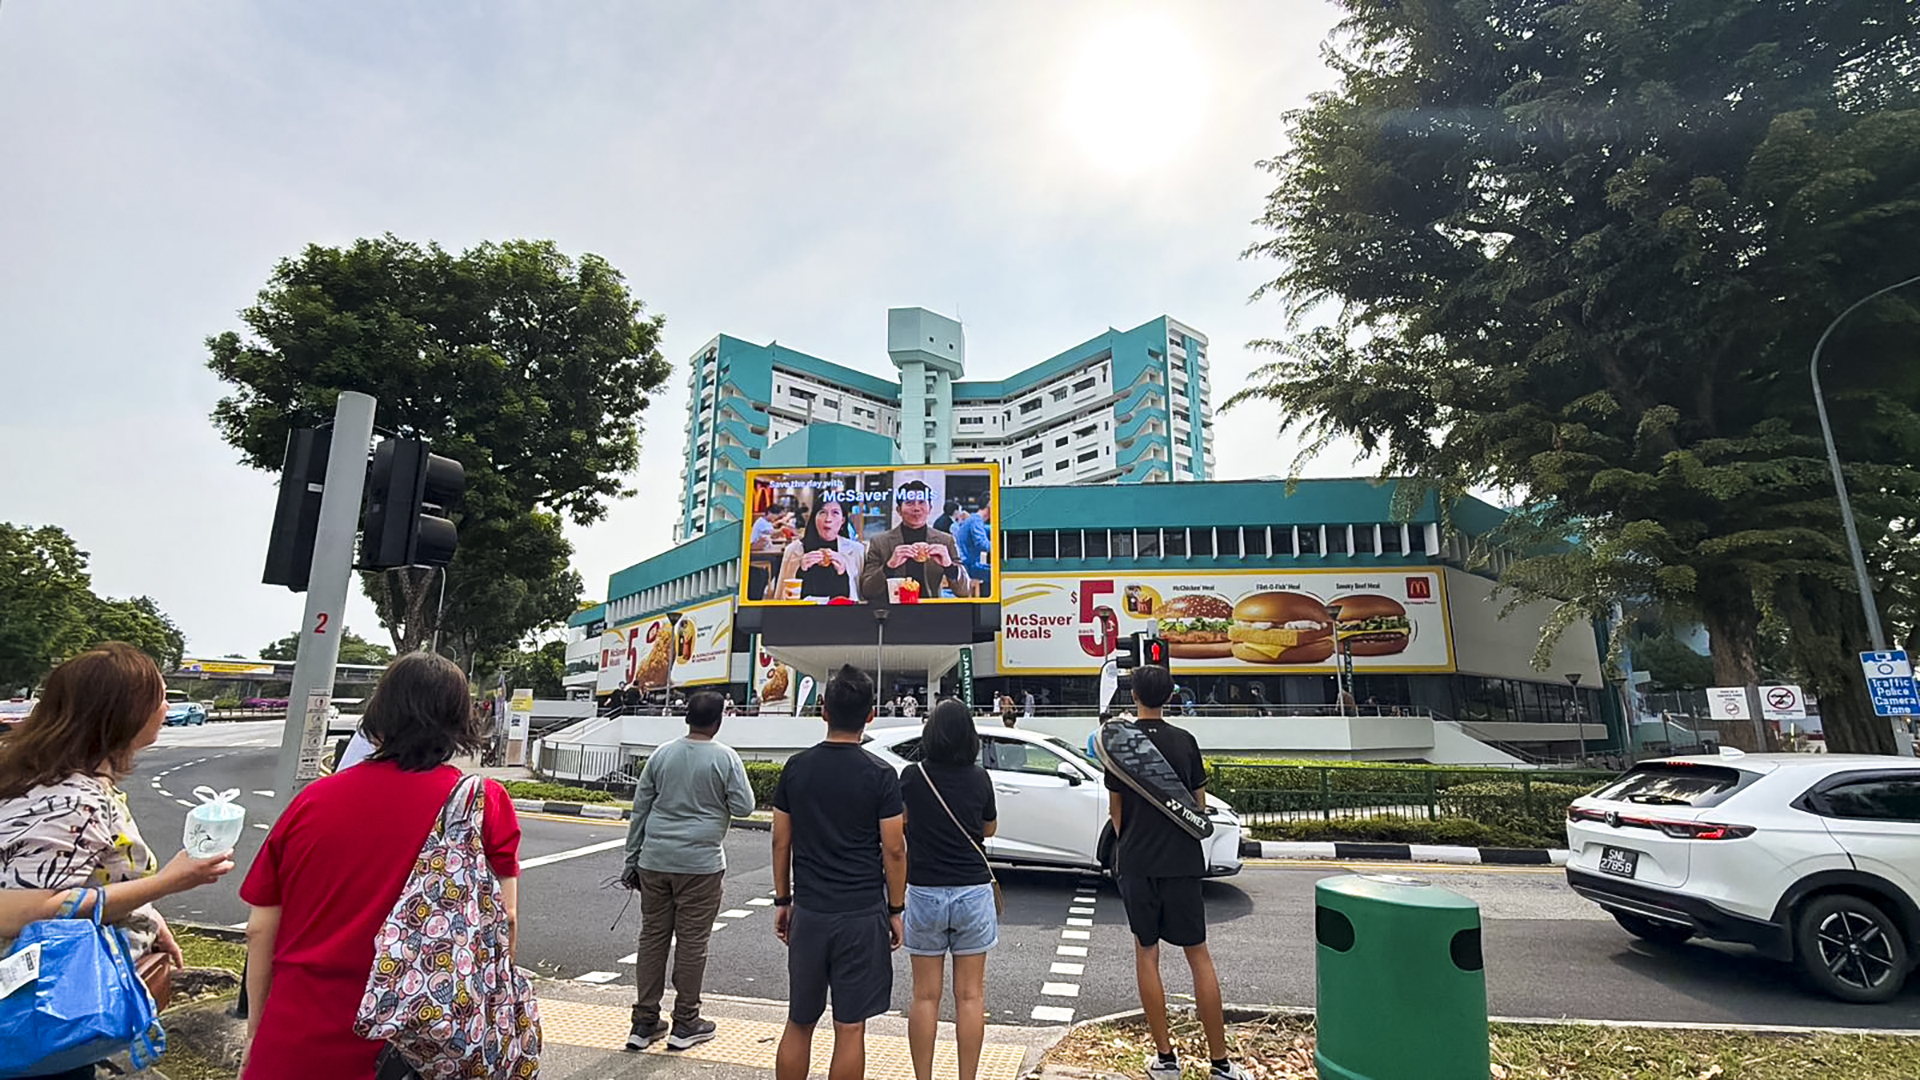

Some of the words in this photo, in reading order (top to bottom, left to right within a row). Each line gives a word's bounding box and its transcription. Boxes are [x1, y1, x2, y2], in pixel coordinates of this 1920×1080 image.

[769, 480, 790, 488] Save
[790, 480, 805, 488] the
[806, 479, 822, 489] day
[823, 479, 843, 488] with
[823, 489, 890, 502] McSaver
[894, 488, 938, 501] Meals
[314, 613, 329, 634] 2
[1005, 614, 1073, 626] McSaver
[1070, 590, 1078, 605] $
[1078, 579, 1119, 658] 5
[1005, 626, 1052, 639] Meals
[625, 627, 639, 684] 5
[1871, 678, 1910, 687] Traffic
[1876, 687, 1910, 696] Police
[1874, 696, 1917, 705] Camera
[1885, 704, 1911, 714] Zone
[1182, 806, 1207, 830] YONEX
[1608, 849, 1626, 862] SNL
[1600, 857, 1633, 873] 2785B
